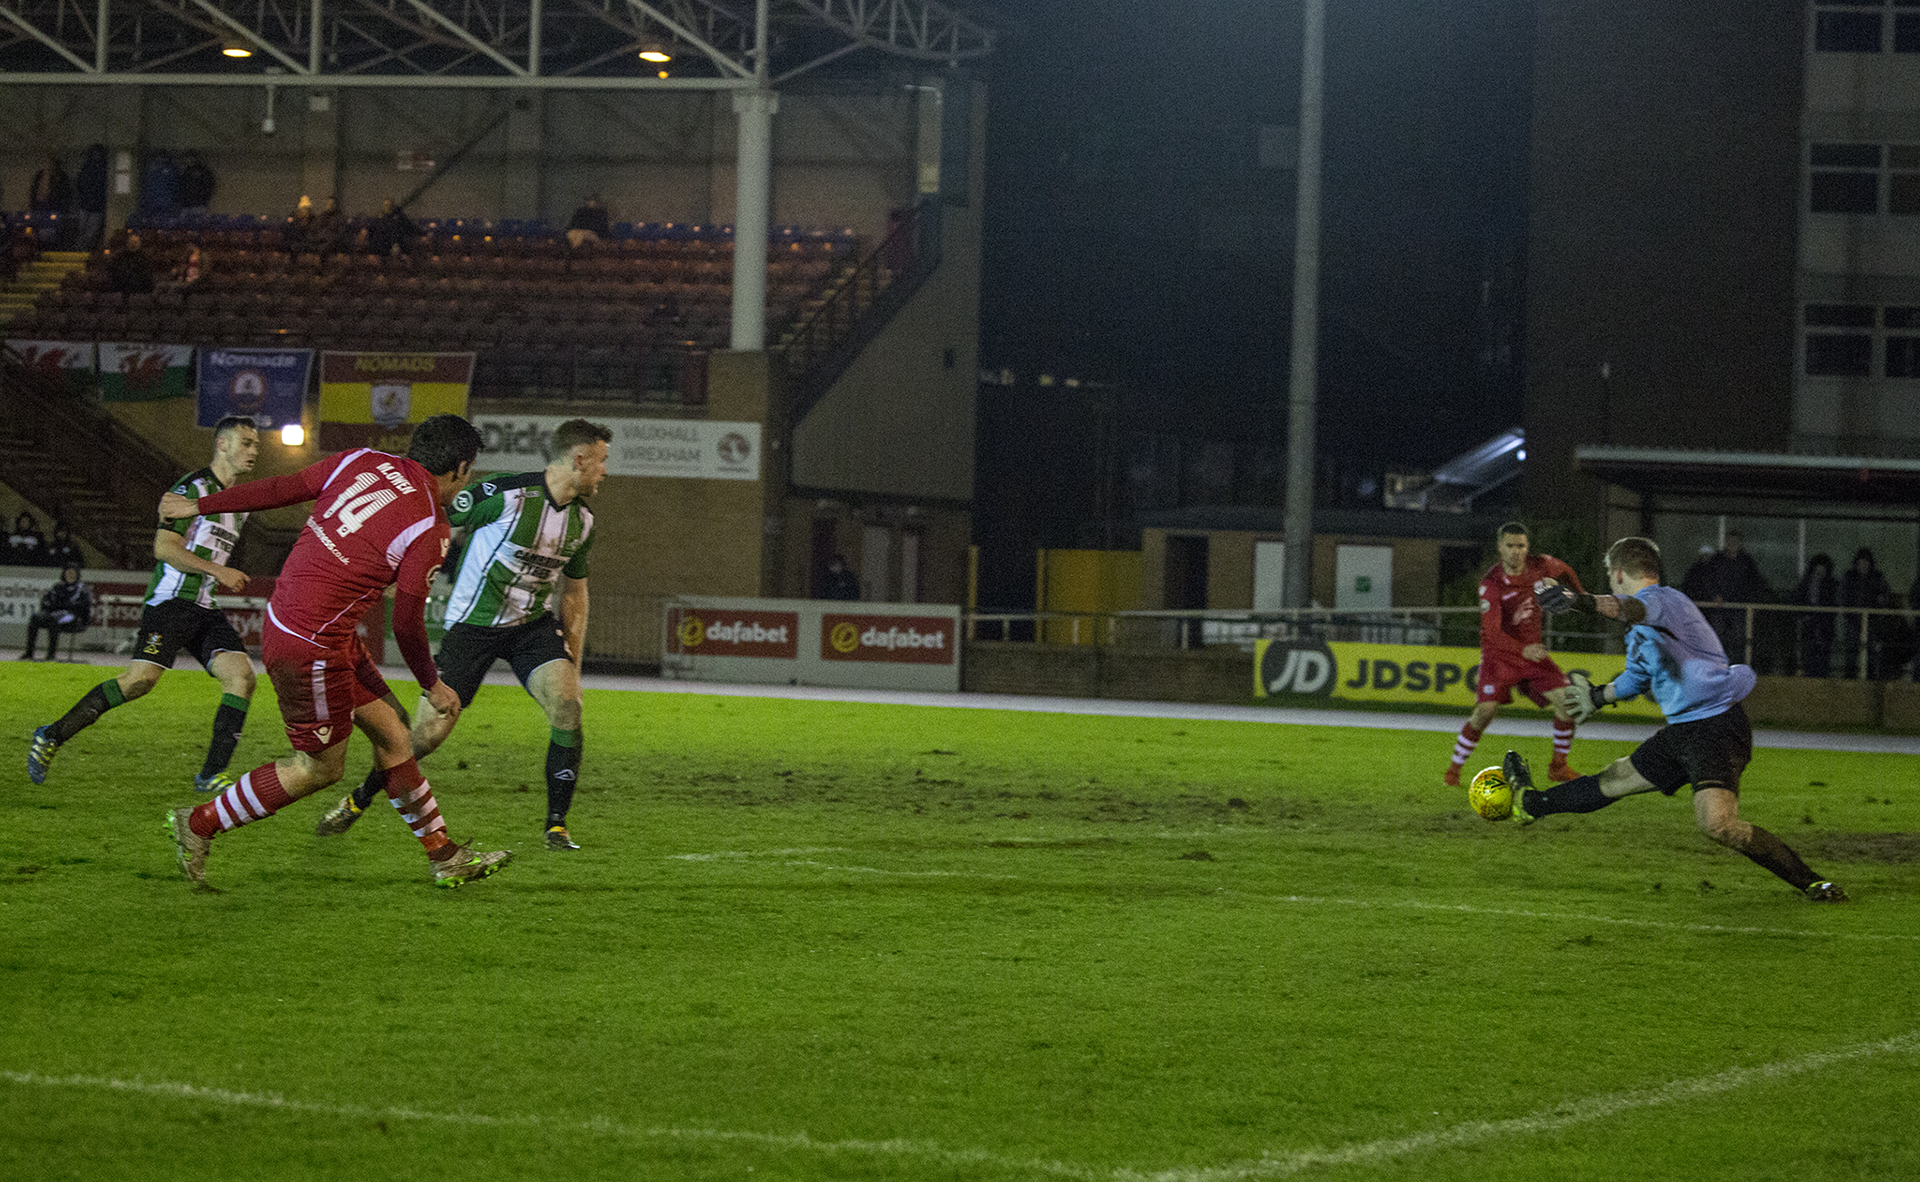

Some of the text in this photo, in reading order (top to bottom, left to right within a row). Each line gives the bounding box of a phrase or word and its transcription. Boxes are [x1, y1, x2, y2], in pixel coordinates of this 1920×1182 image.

[355, 356, 436, 372] NOMADS
[623, 425, 699, 441] VAUXHALL
[623, 446, 700, 462] WREXHAM
[376, 462, 417, 495] M.OWEN
[323, 472, 398, 538] 14
[706, 620, 788, 645] dafabet
[861, 626, 944, 651] dafabet
[1268, 649, 1331, 693] JD
